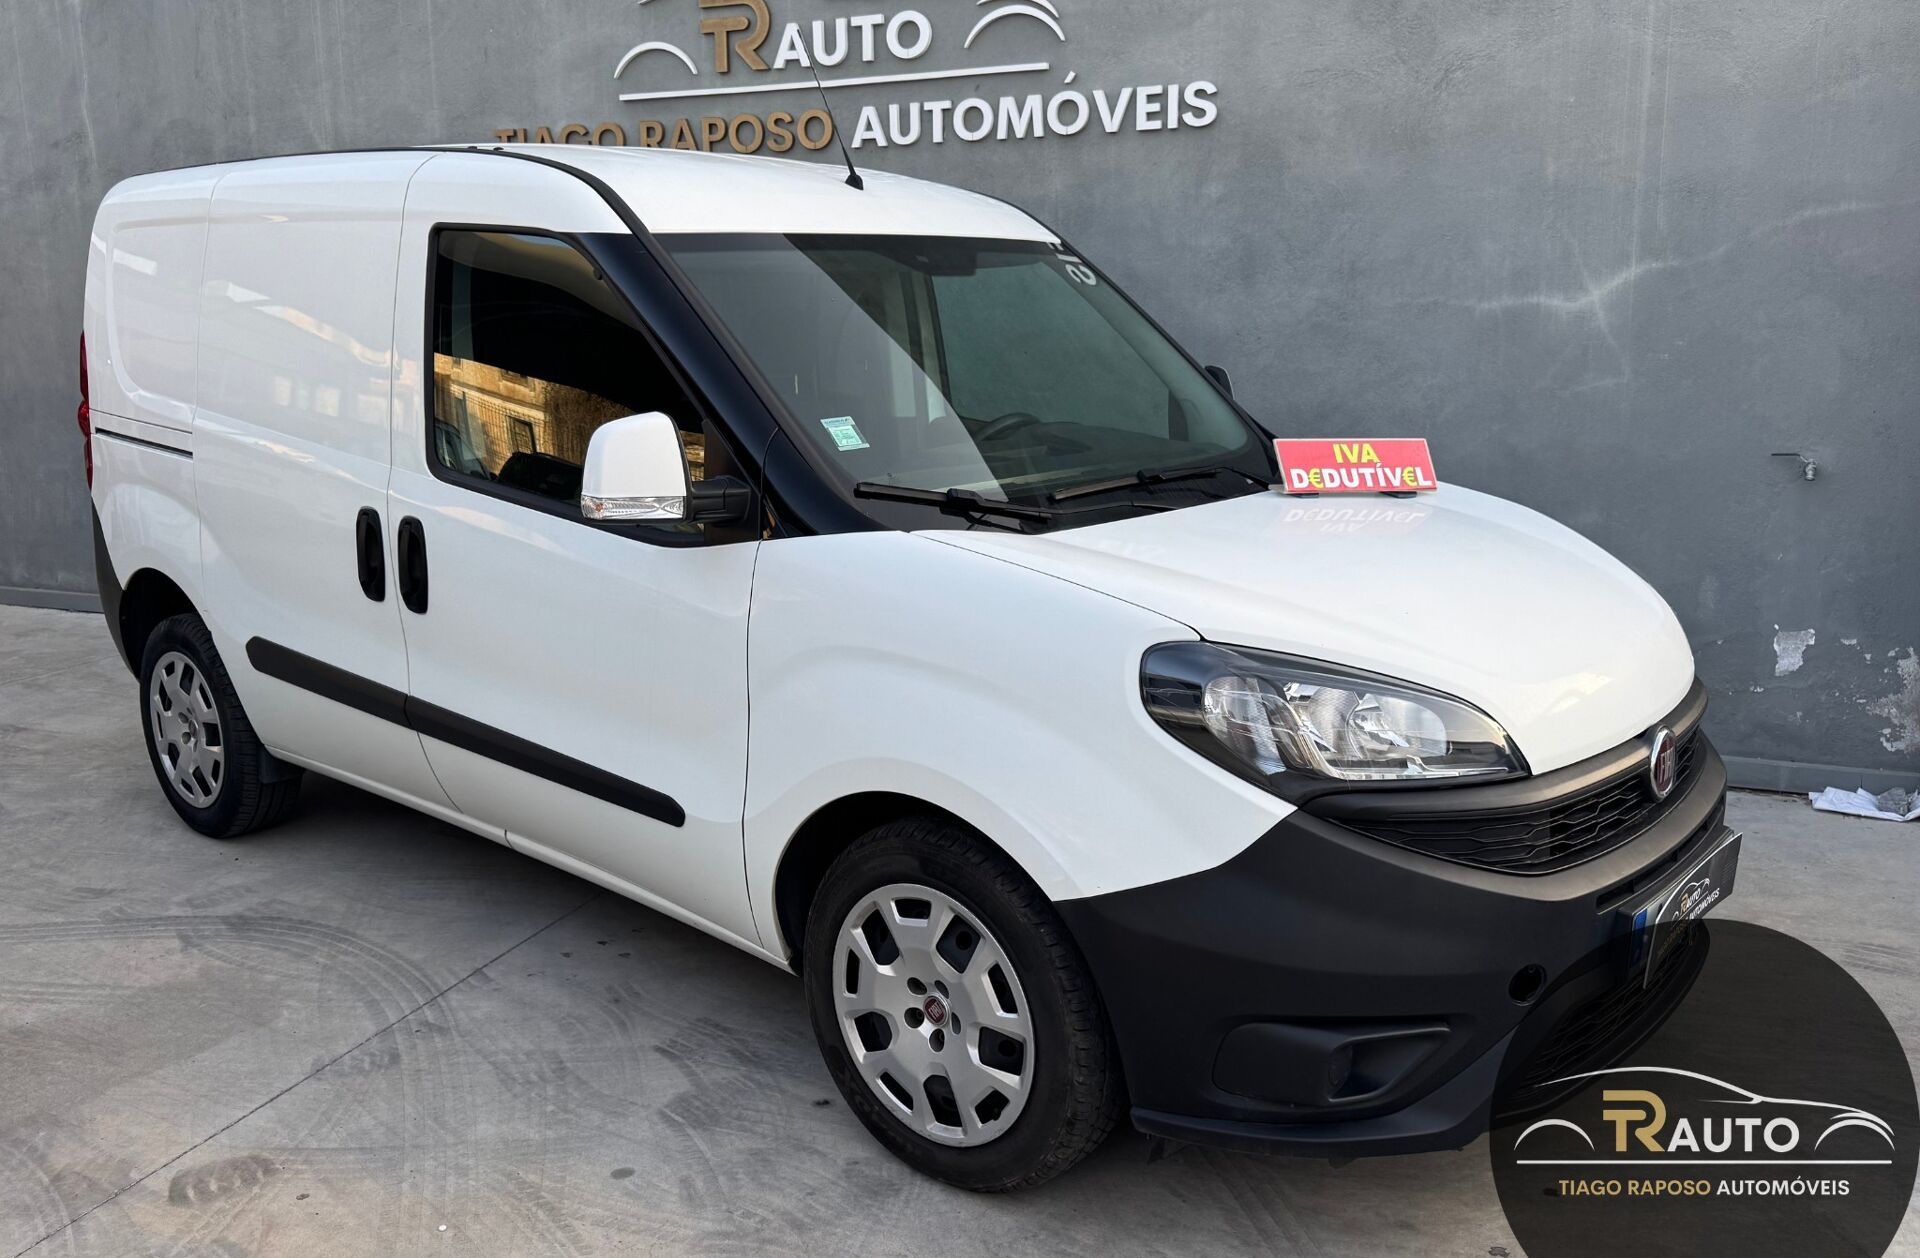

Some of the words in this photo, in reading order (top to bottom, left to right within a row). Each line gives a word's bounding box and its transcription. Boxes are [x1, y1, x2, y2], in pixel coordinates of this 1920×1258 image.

[639, 109, 835, 154] RAPOSO
[850, 71, 1218, 149] AUTOMÓVEIS
[1333, 443, 1380, 464] IVA
